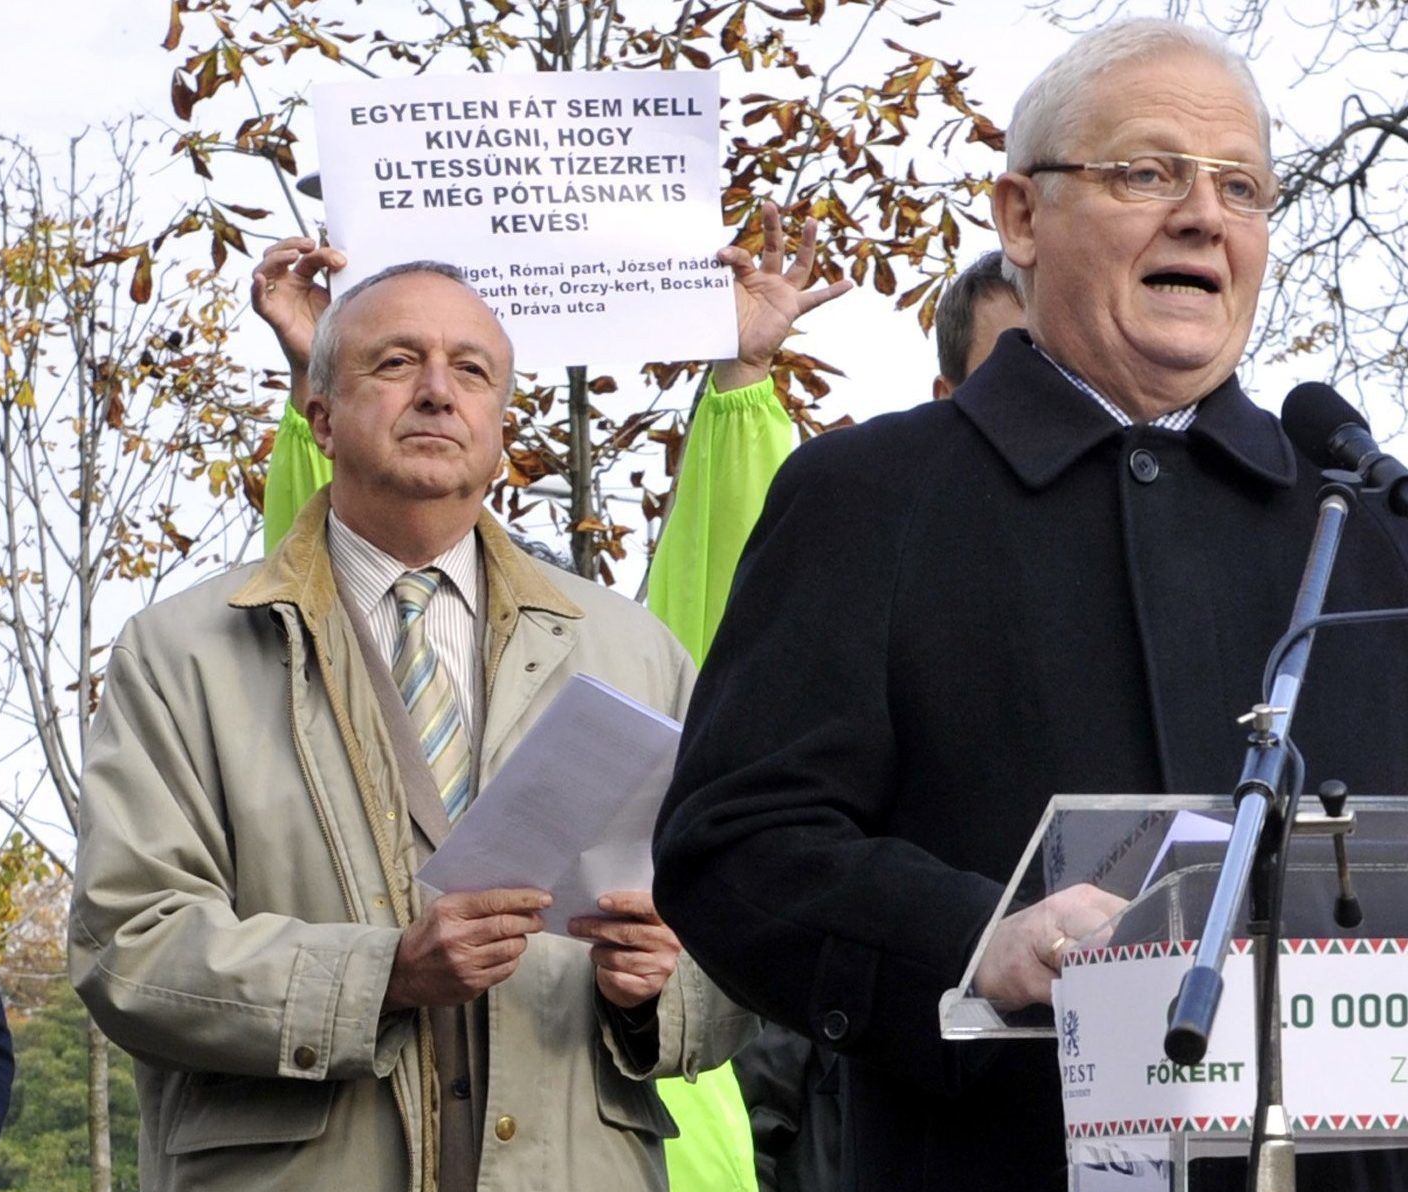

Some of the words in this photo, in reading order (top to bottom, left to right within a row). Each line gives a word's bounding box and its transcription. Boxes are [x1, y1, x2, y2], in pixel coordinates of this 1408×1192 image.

[350, 100, 499, 126] EGYETLEN
[509, 95, 558, 119] FÁT
[567, 98, 622, 119] SEM
[633, 97, 703, 117] KELL
[425, 125, 549, 150] KIVÁGNI,
[558, 127, 633, 147] HOGY
[374, 154, 542, 181] ÜLTESSÜNK
[550, 153, 686, 176] TÍZEZRET!
[379, 189, 415, 210] EZ
[423, 184, 484, 208] MÉG
[493, 181, 654, 206] PÓTLÁSNAK
[662, 184, 687, 202] IS
[491, 209, 589, 234] KEVÉS!
[510, 263, 566, 277] Római
[571, 260, 612, 278] part,
[617, 255, 673, 274] József
[524, 281, 555, 298] tér,
[559, 276, 656, 297] Orczy-kert,
[661, 274, 730, 291] Bocskai
[511, 300, 562, 316] Dráva
[567, 298, 606, 313] utca
[1331, 993, 1408, 1028] 000
